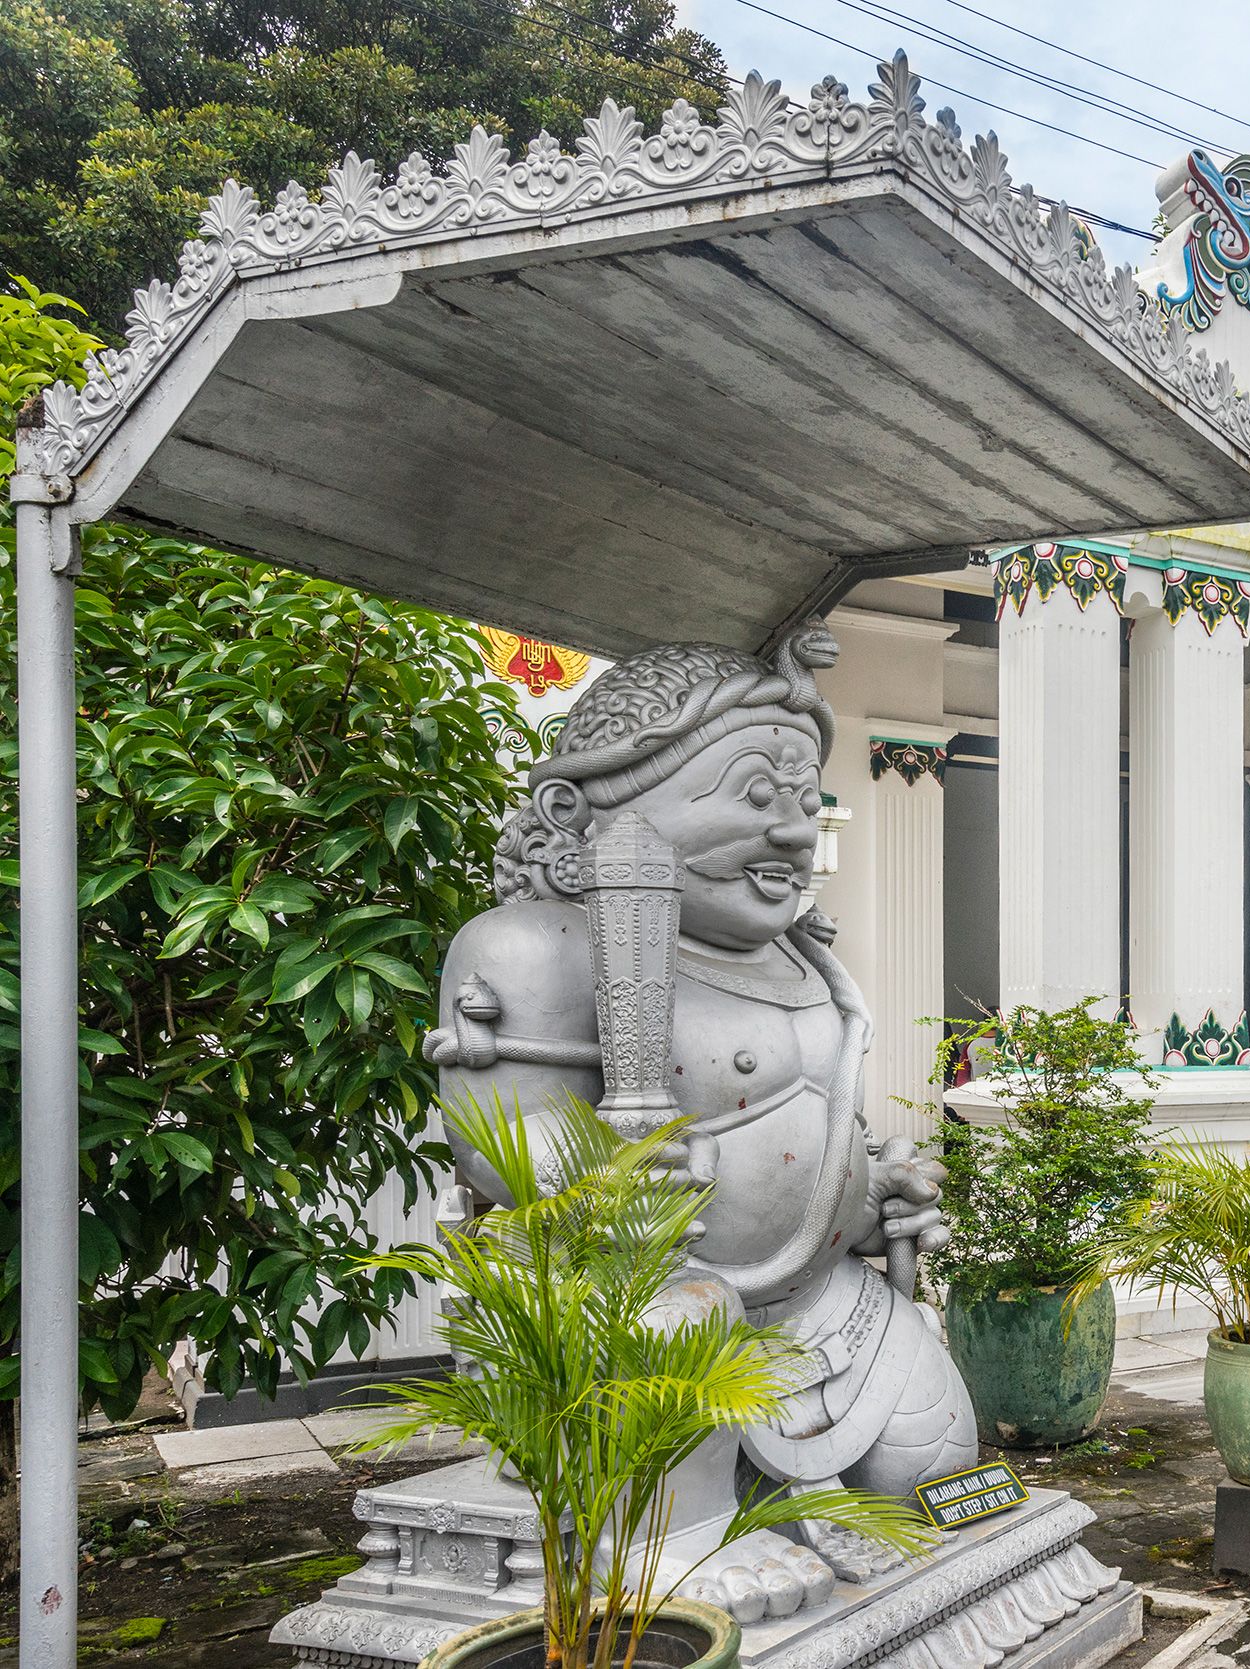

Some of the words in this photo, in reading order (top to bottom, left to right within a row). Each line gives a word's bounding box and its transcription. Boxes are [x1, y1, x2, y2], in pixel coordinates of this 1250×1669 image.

[926, 1481, 966, 1505] DILARANG
[962, 1475, 984, 1493] NAIK
[982, 1468, 1011, 1487] DUDUK
[940, 1503, 966, 1523] DON'T
[962, 1497, 983, 1516] STEP
[984, 1492, 1000, 1509] SIT
[995, 1489, 1011, 1505] ON
[1006, 1486, 1018, 1501] IT
